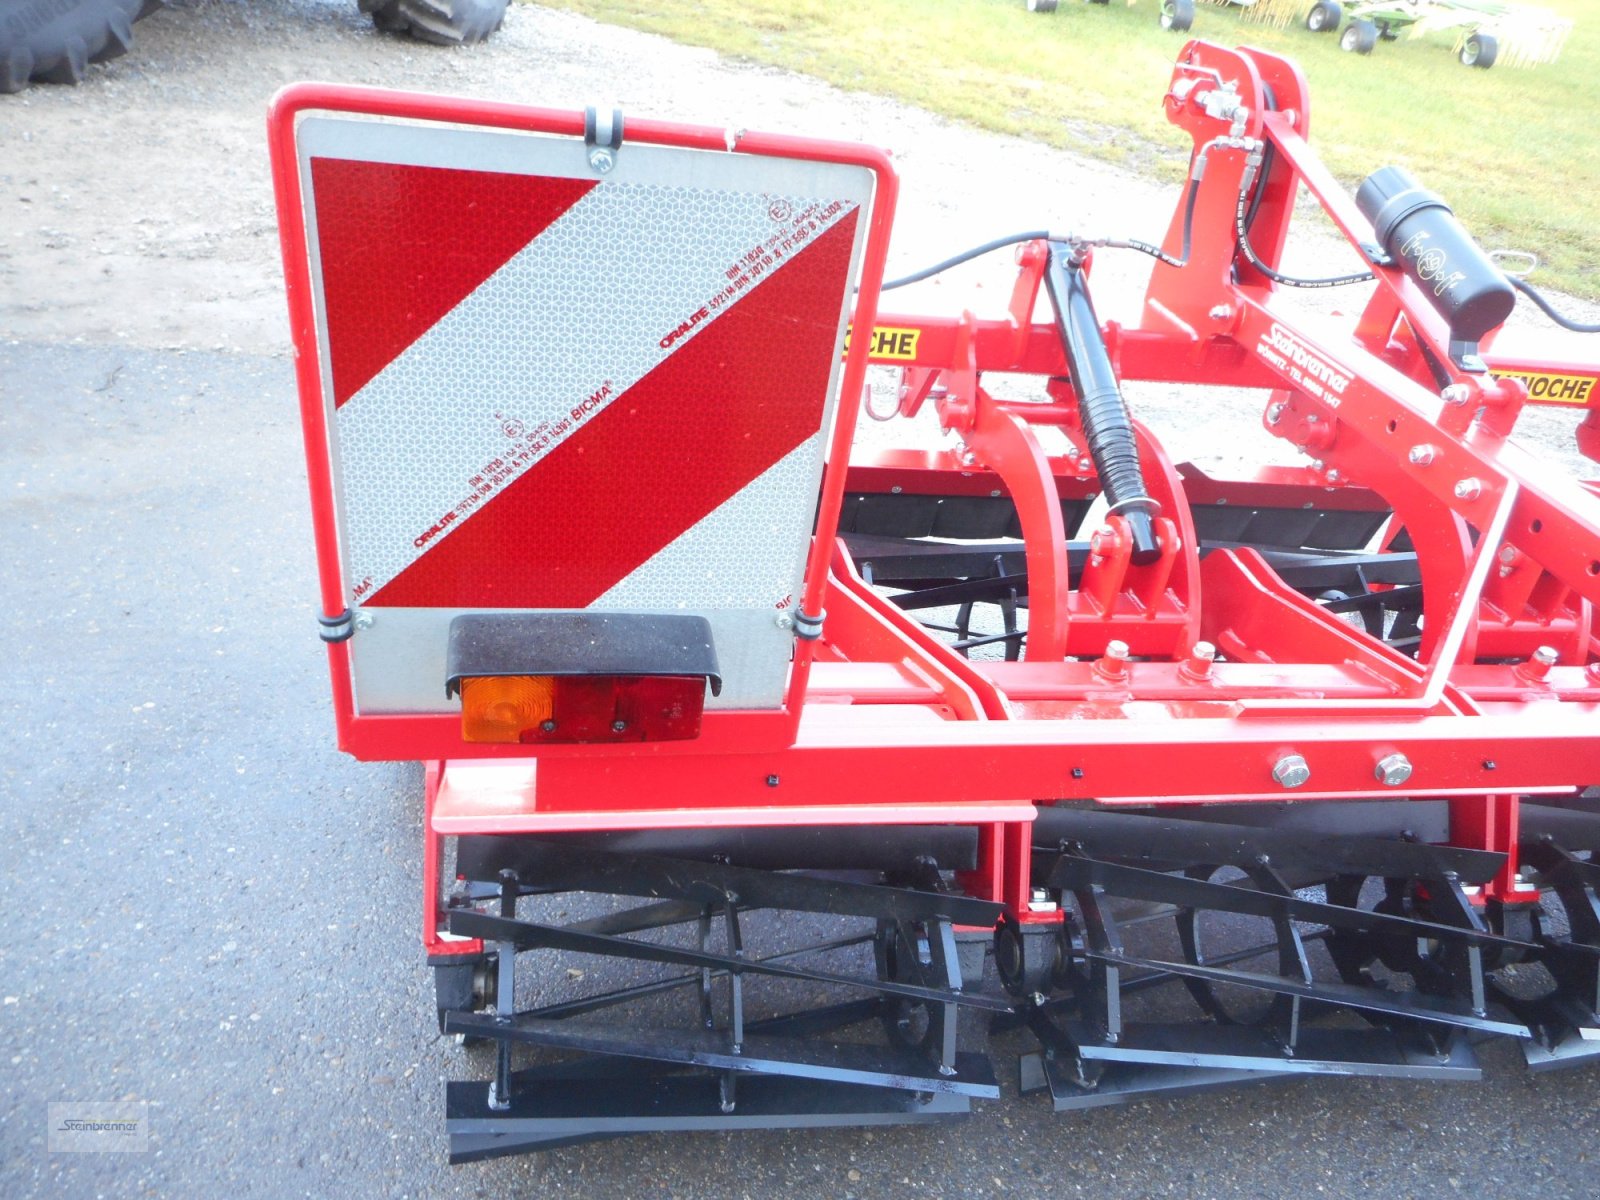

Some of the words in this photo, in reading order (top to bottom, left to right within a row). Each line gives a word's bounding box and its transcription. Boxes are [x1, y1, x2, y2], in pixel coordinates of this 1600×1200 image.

[660, 306, 709, 348] ORALITE
[733, 274, 749, 289] DIN
[748, 255, 772, 277] 30710
[414, 511, 456, 547] ORALITE
